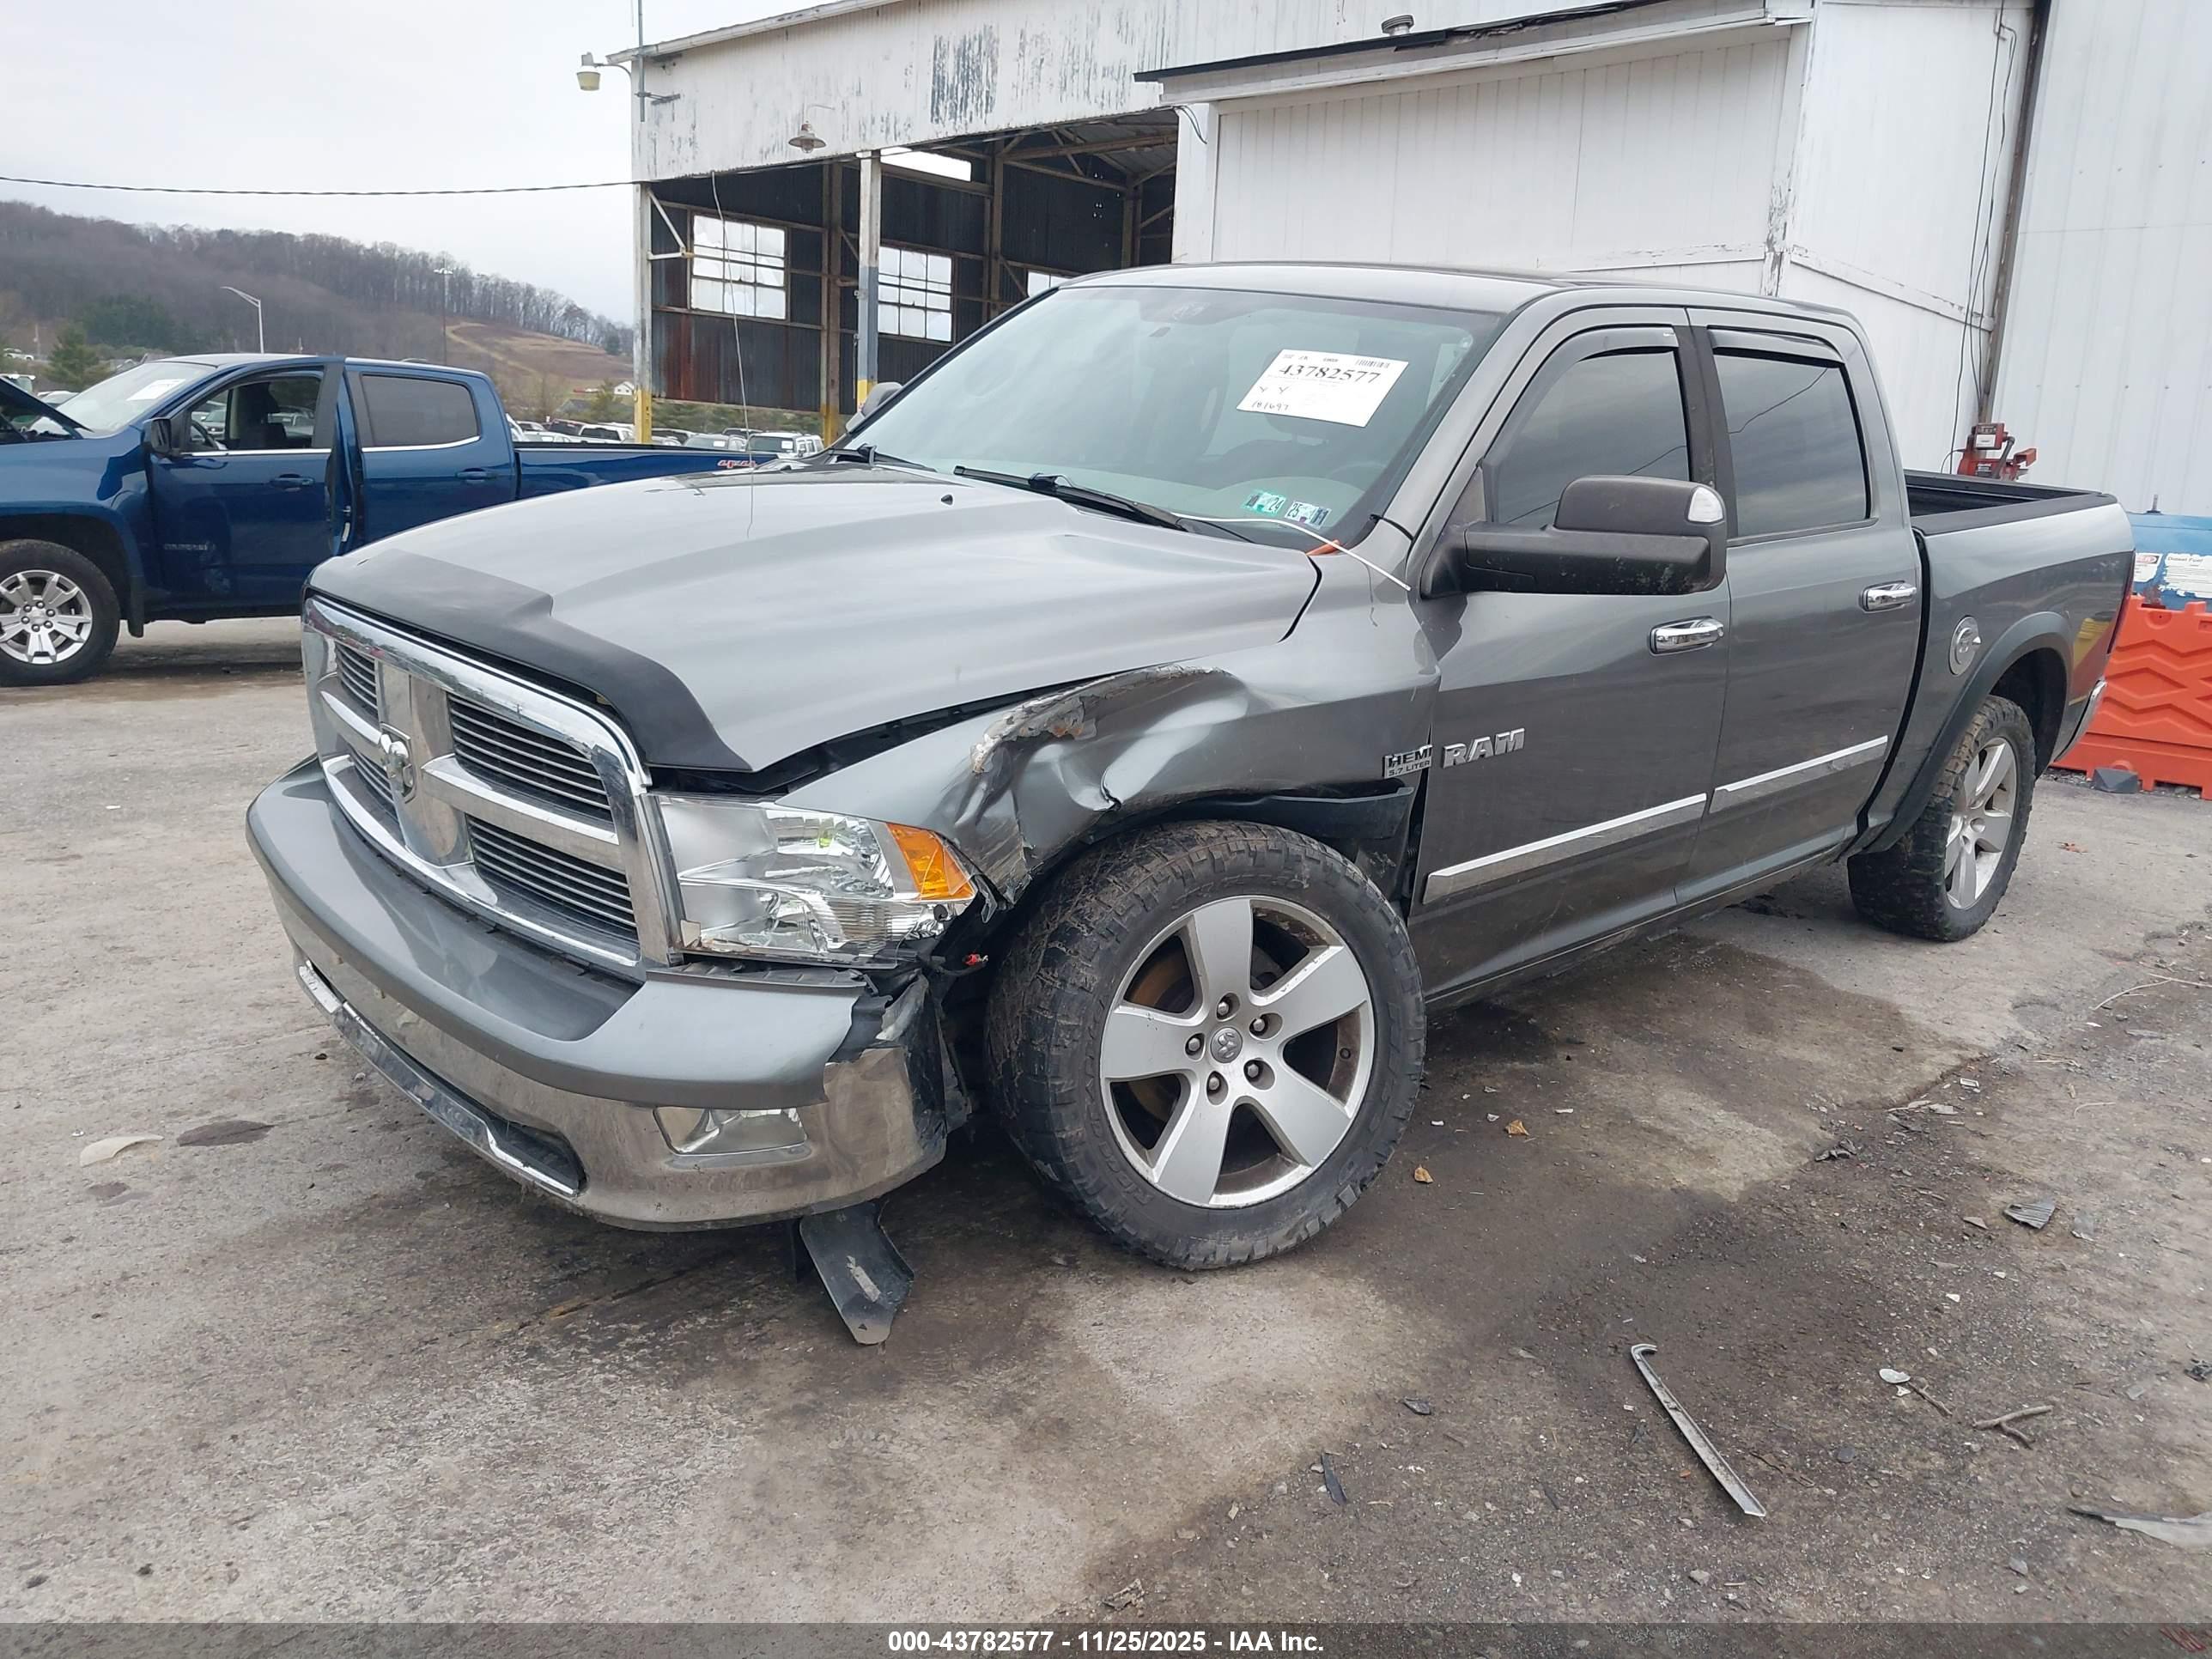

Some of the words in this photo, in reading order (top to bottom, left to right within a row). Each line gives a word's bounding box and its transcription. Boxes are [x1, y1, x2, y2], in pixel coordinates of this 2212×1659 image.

[1279, 364, 1382, 384] 43782577
[1287, 502, 1304, 518] 25
[1388, 746, 1432, 768] HEMI
[1442, 728, 1525, 769] RAM
[1389, 767, 1404, 777] 5.7
[1406, 760, 1431, 772] LITER
